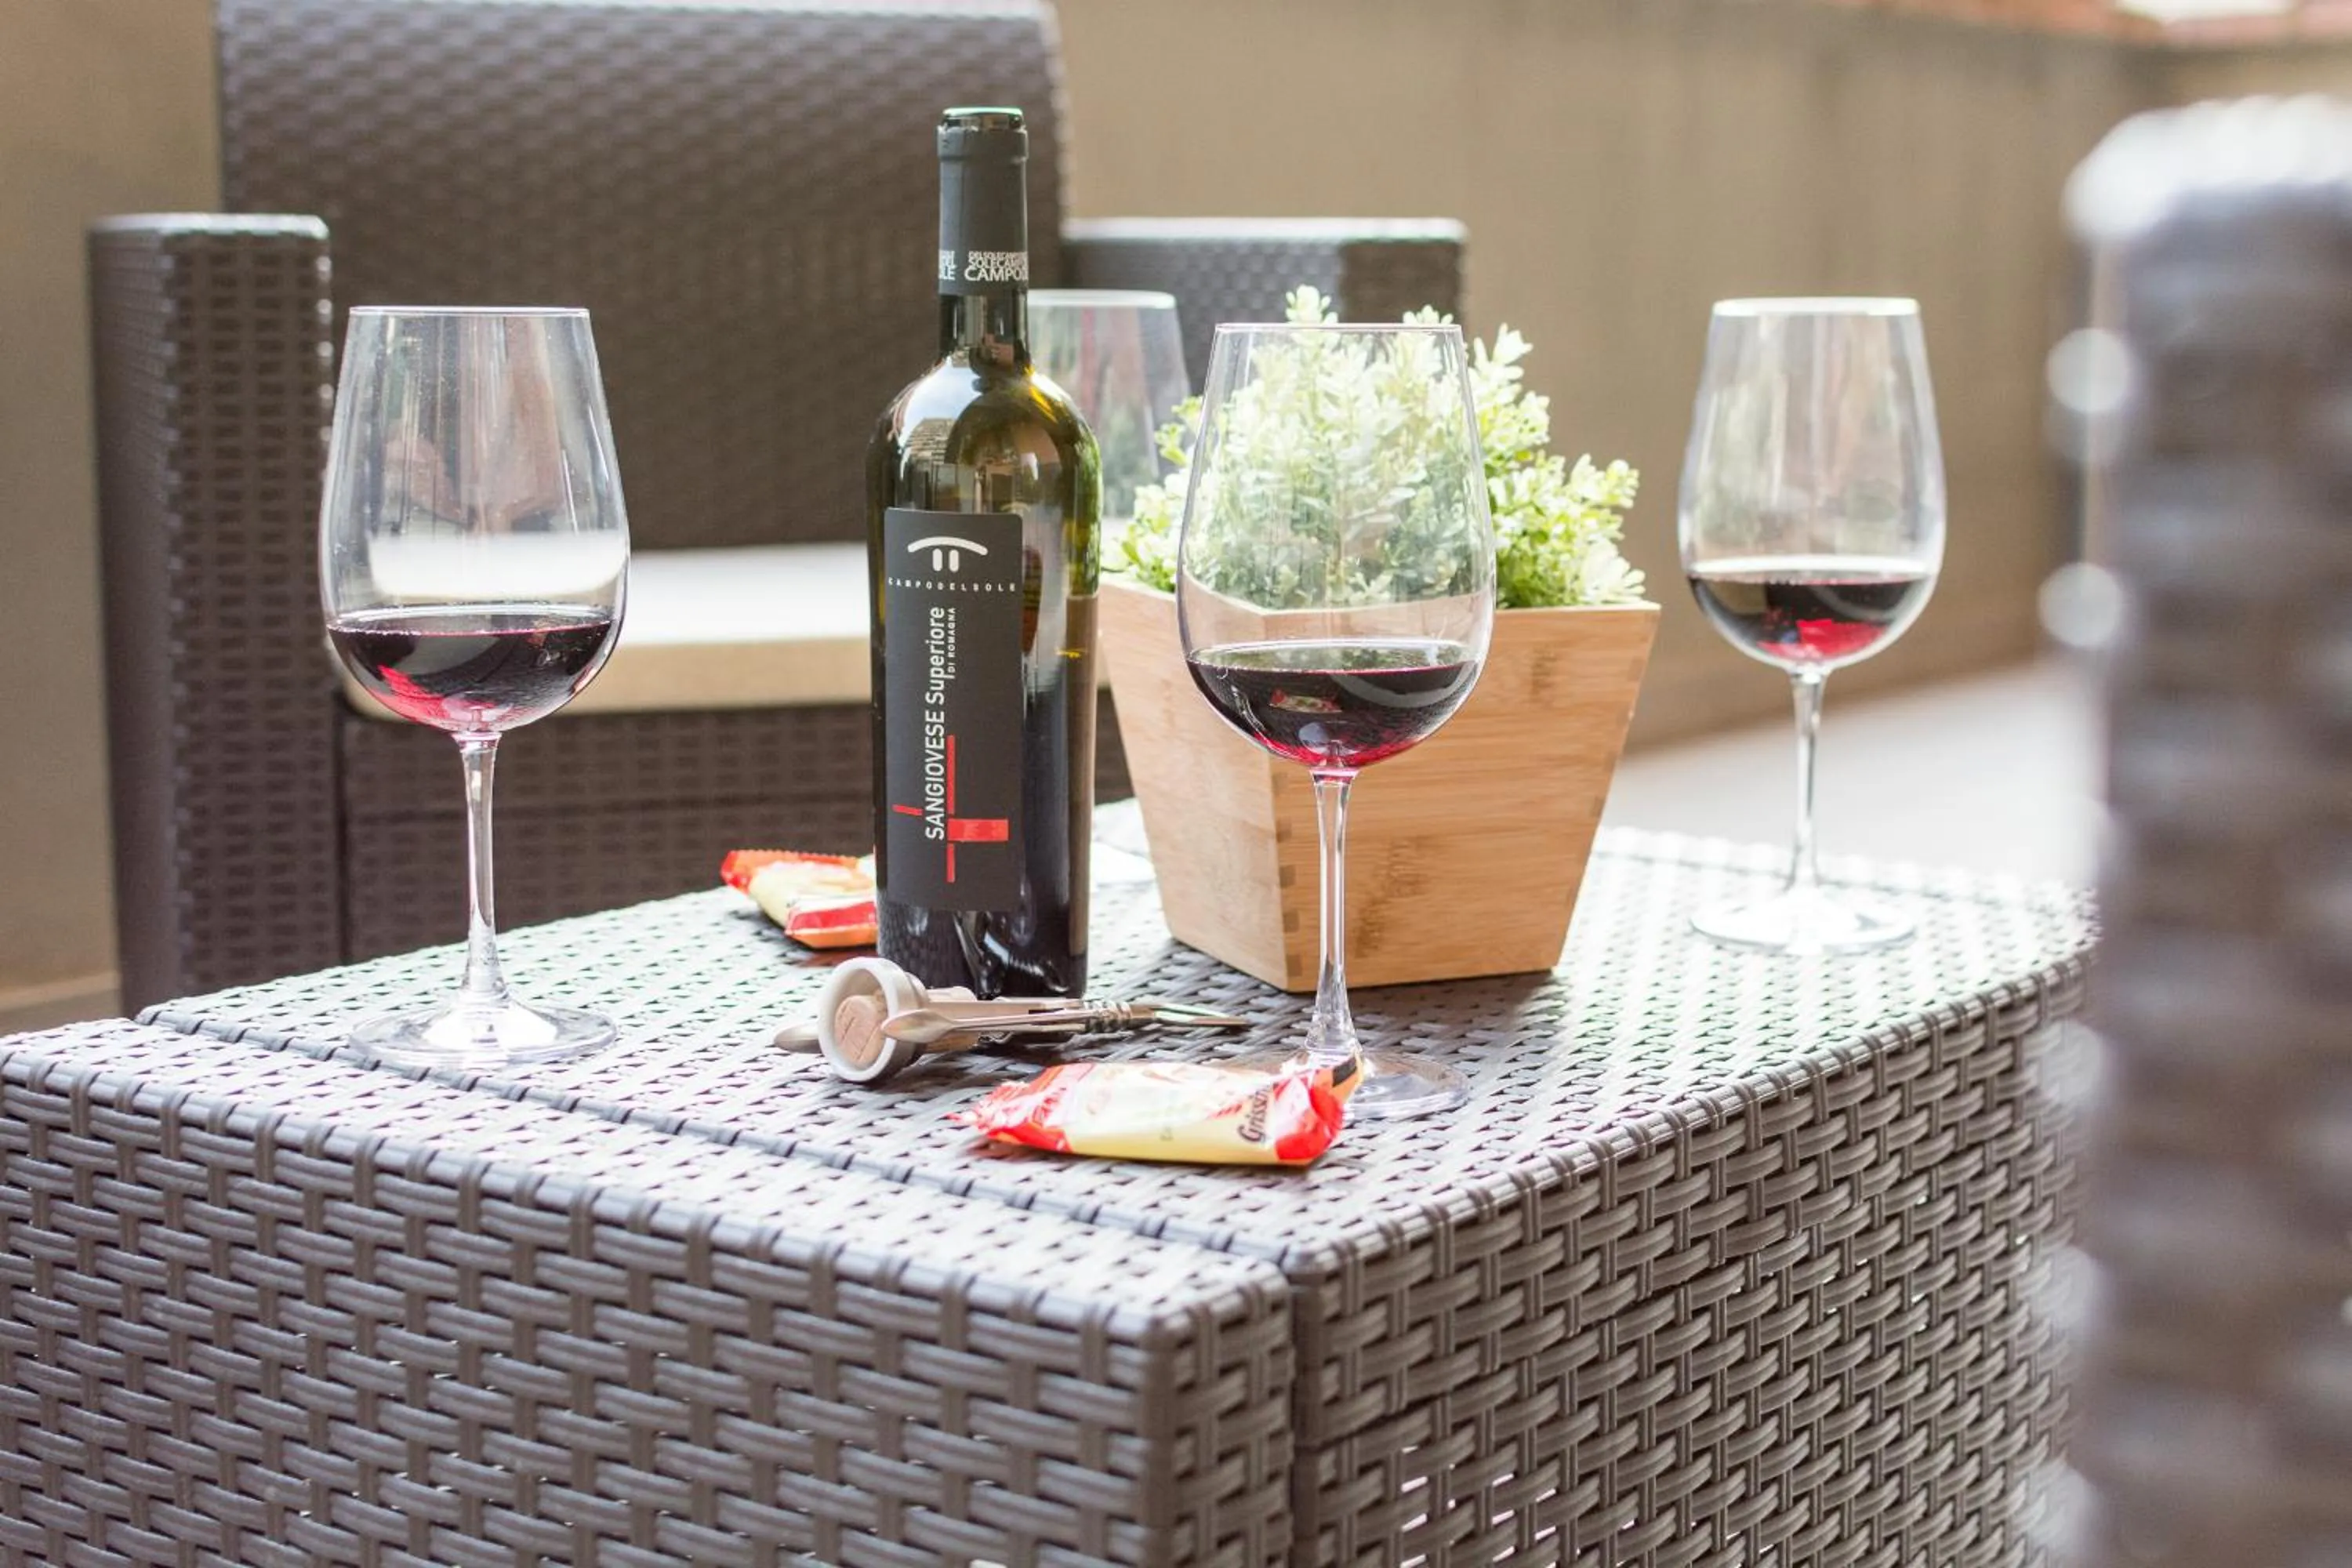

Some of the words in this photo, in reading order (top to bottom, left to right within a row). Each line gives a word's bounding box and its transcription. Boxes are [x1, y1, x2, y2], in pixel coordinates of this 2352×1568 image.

[925, 607, 955, 705] Superiore
[947, 608, 956, 658] ROMAGNA
[947, 662, 956, 673] DI
[925, 710, 945, 840] SANGIOVESE
